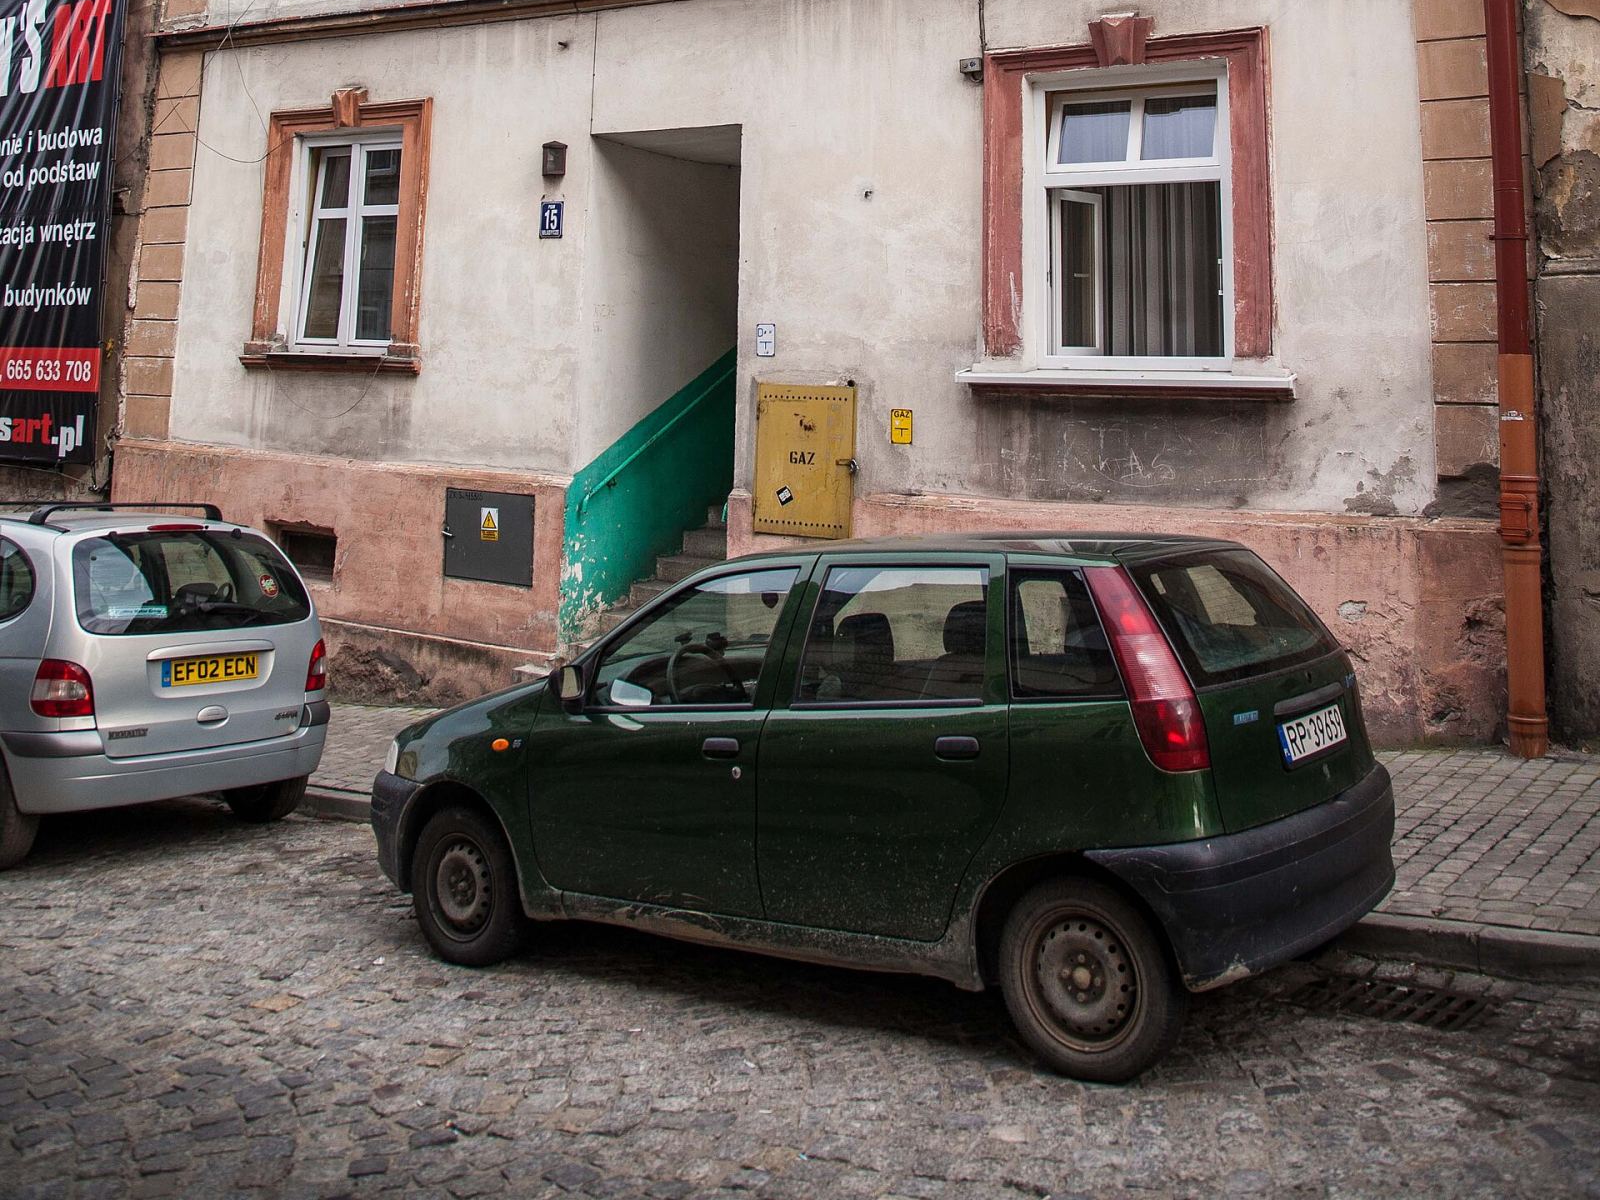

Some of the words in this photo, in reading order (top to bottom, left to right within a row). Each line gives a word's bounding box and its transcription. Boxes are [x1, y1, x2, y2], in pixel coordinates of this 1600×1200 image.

[0, 132, 23, 156] nie
[27, 131, 33, 153] i
[37, 125, 103, 152] budowa
[3, 163, 24, 188] od
[27, 158, 101, 191] podstaw
[0, 220, 34, 250] acja
[39, 217, 96, 247] wnętrz
[544, 209, 558, 230] 15
[3, 280, 92, 312] budynków
[6, 359, 32, 380] 665
[35, 360, 61, 381] 633
[65, 360, 92, 382] 708
[893, 410, 911, 419] GAZ
[789, 450, 816, 466] GAZ
[173, 659, 220, 682] EF02
[223, 655, 256, 677] ECN
[1285, 721, 1307, 757] RP
[1308, 707, 1343, 748] 39659
